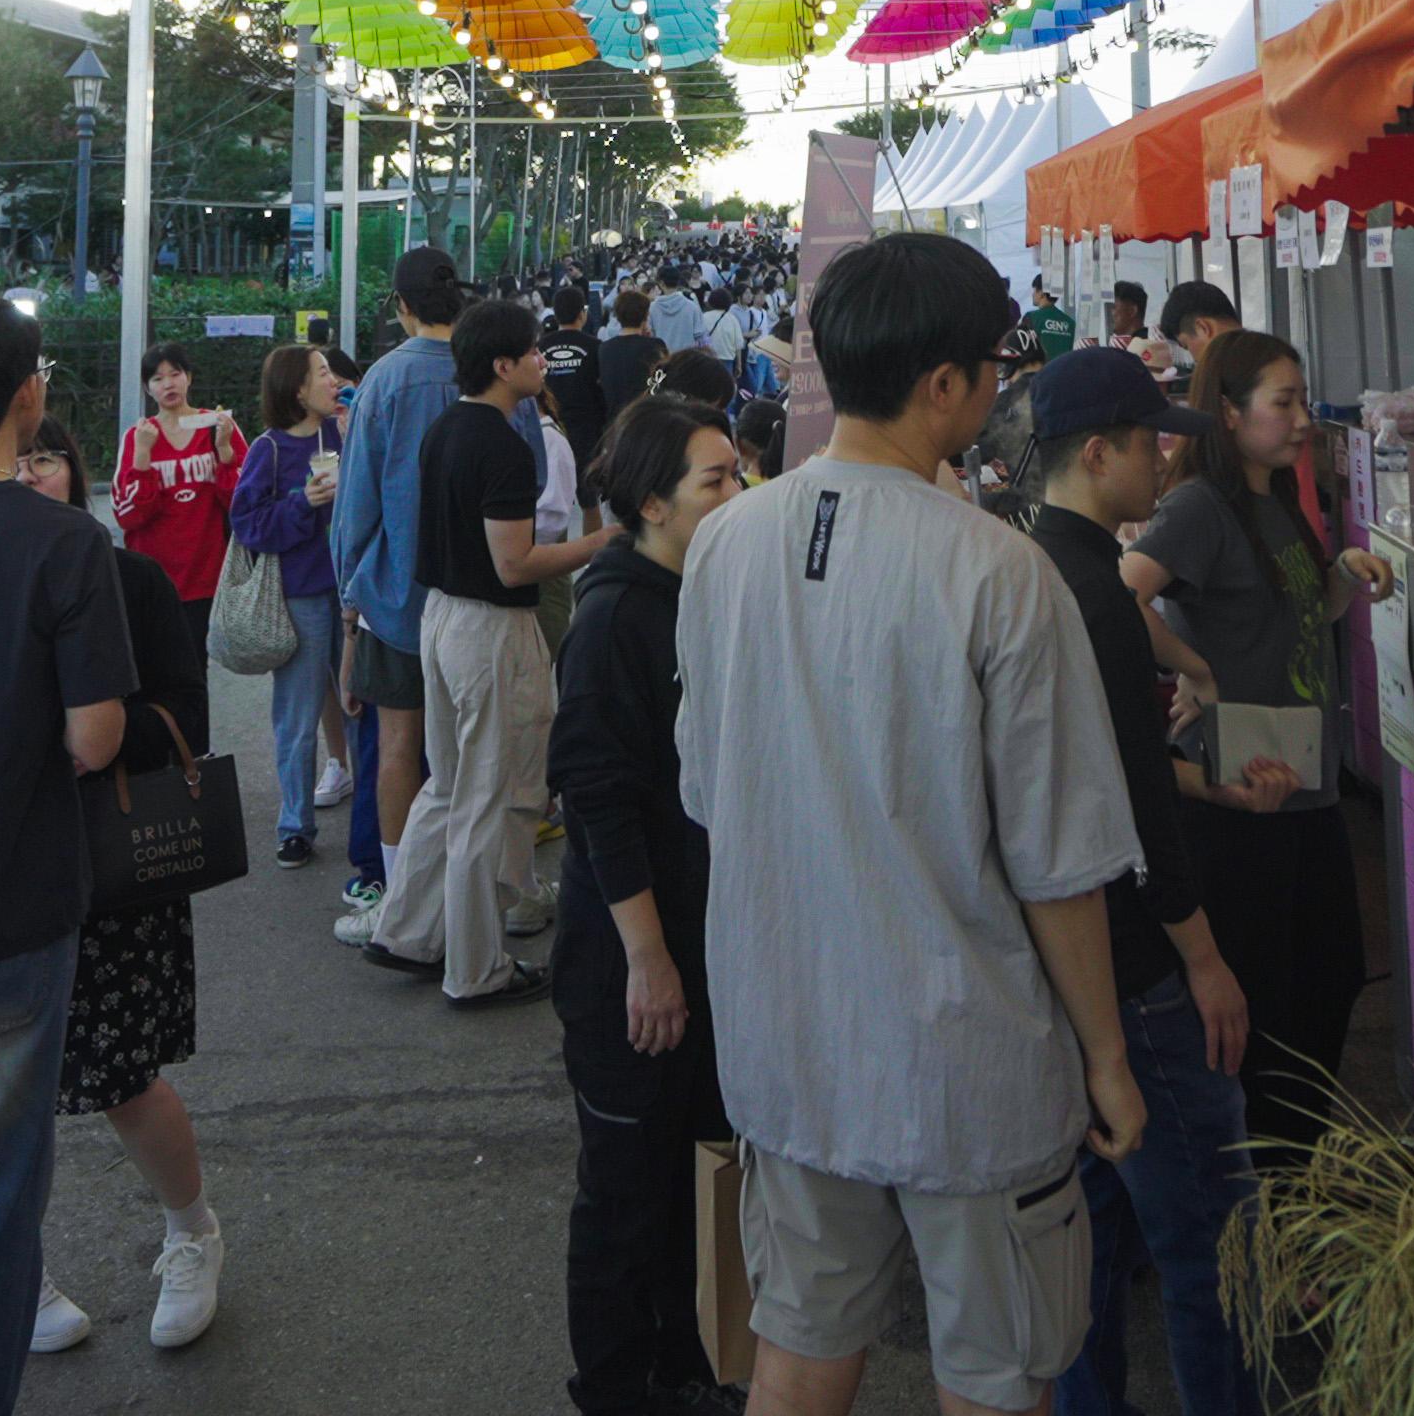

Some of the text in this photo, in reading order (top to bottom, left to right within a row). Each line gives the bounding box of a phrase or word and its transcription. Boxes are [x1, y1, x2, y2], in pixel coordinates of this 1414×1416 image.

[131, 816, 202, 844] BRILLA
[133, 836, 203, 863] COME UN
[136, 855, 205, 882] CRISTALLO
